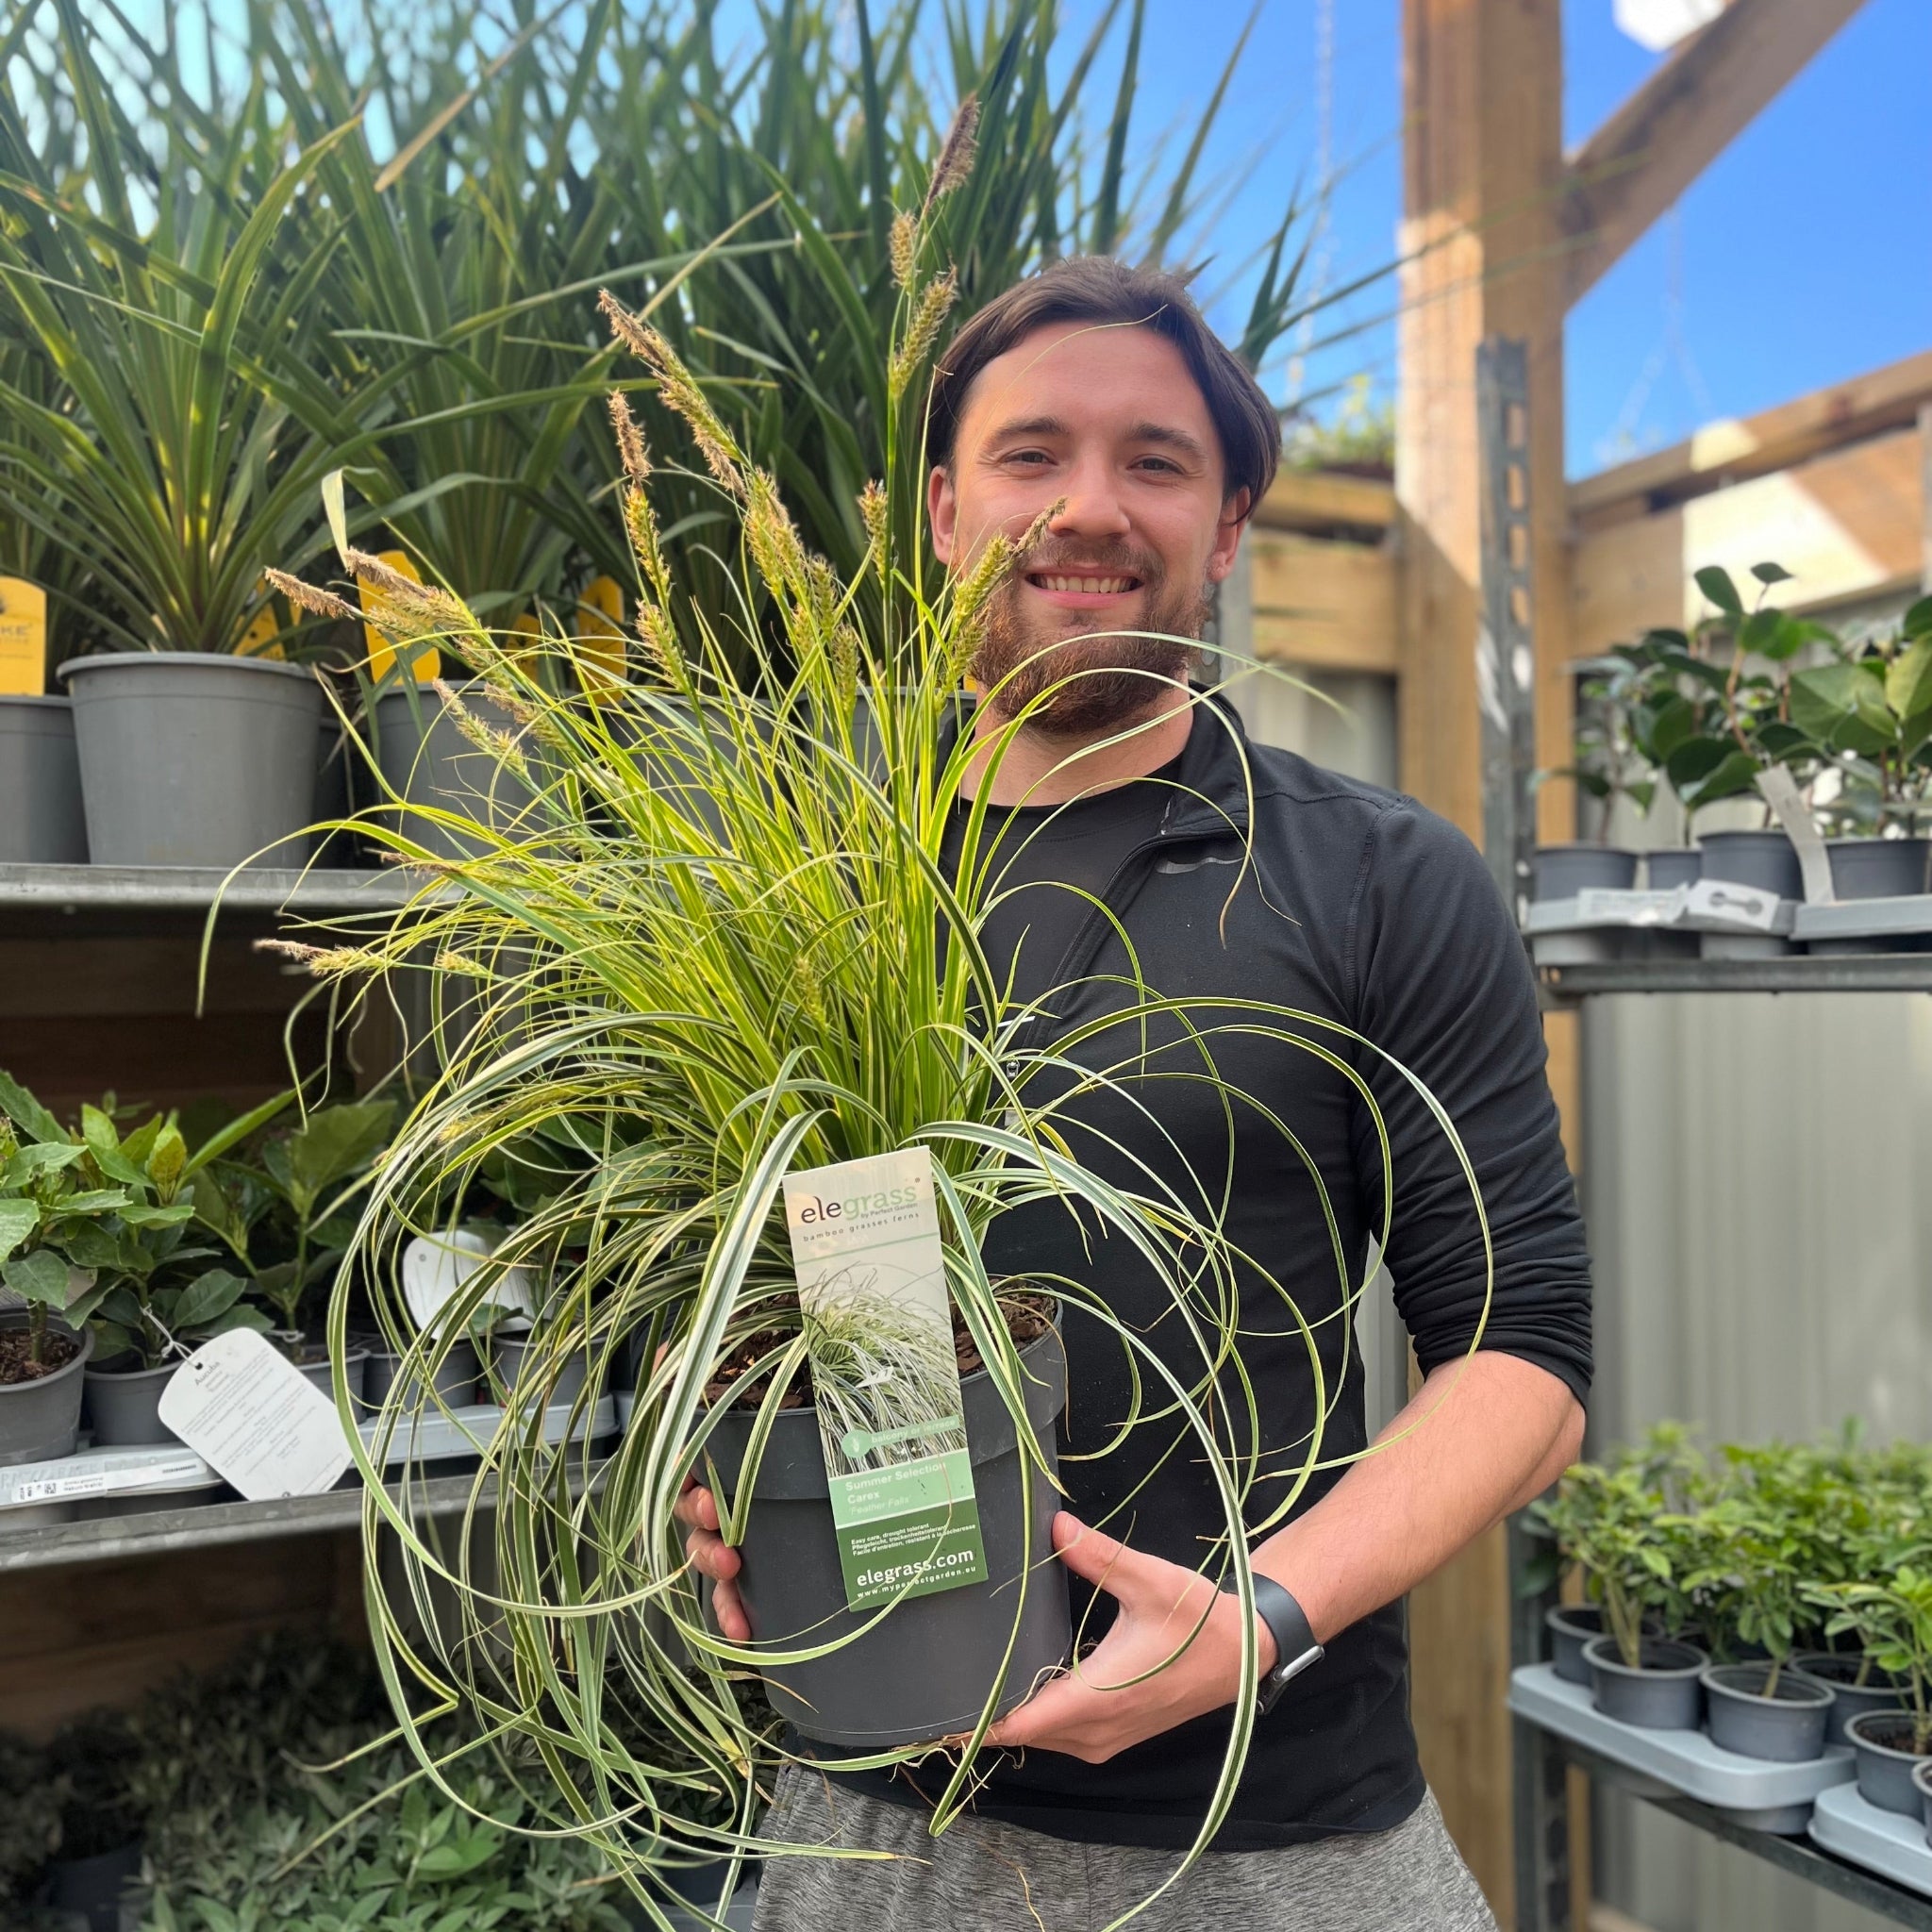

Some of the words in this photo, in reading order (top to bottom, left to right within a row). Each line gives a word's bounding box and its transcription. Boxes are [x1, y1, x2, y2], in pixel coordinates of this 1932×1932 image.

[801, 1186, 917, 1224] elegrass
[804, 1228, 844, 1242] bamboo
[849, 1219, 889, 1233] grasses
[892, 1212, 920, 1223] ferns
[871, 1430, 908, 1443] balcony
[845, 1474, 892, 1491] Summer
[894, 1461, 946, 1481] Selection
[847, 1491, 880, 1504] Carex
[857, 1549, 974, 1587] elegrass.com
